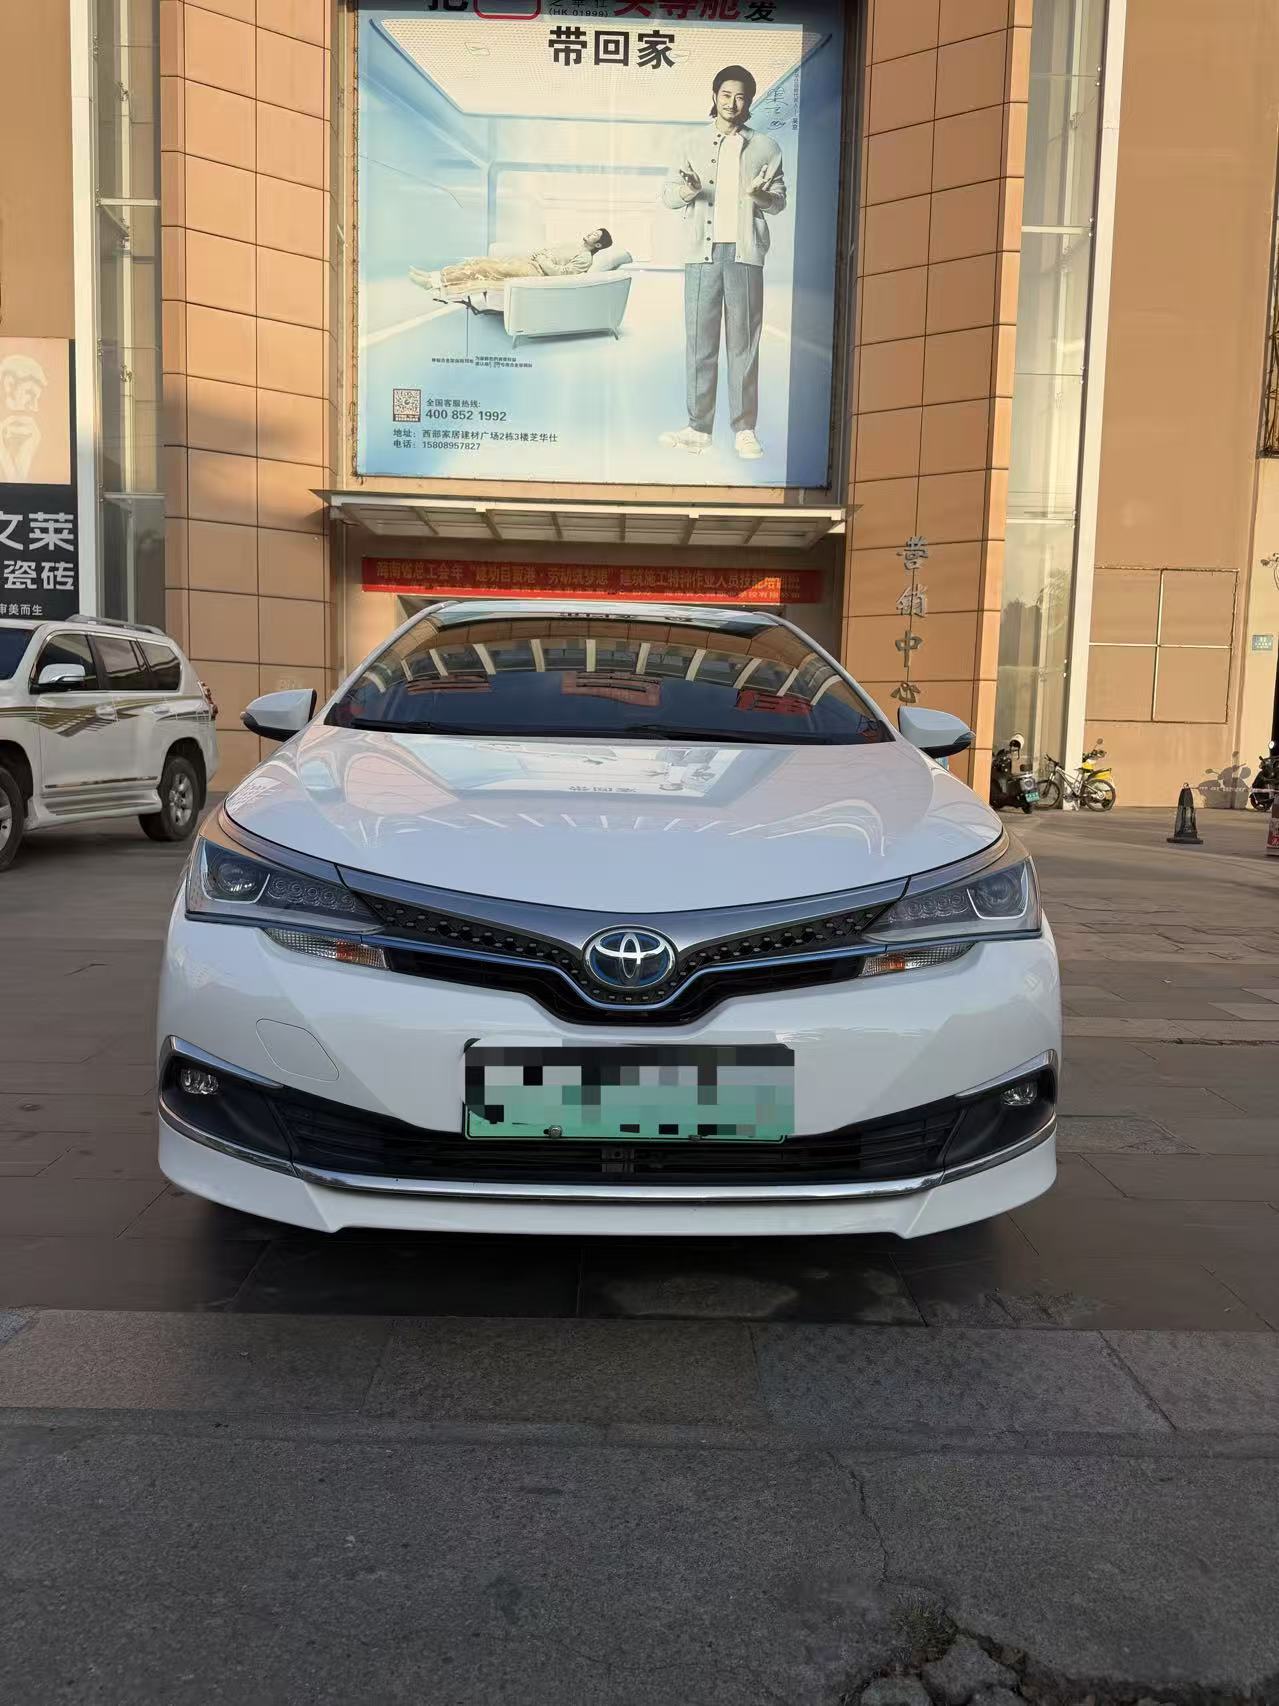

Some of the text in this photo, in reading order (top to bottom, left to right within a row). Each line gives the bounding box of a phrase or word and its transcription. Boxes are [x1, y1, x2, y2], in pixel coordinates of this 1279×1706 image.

[548, 25, 676, 70] 带回家
[425, 409, 507, 422] 400 852 1992
[426, 398, 481, 409] 全国客服热线:
[3, 560, 75, 590] 瓷砖
[889, 535, 930, 705] 营销中心
